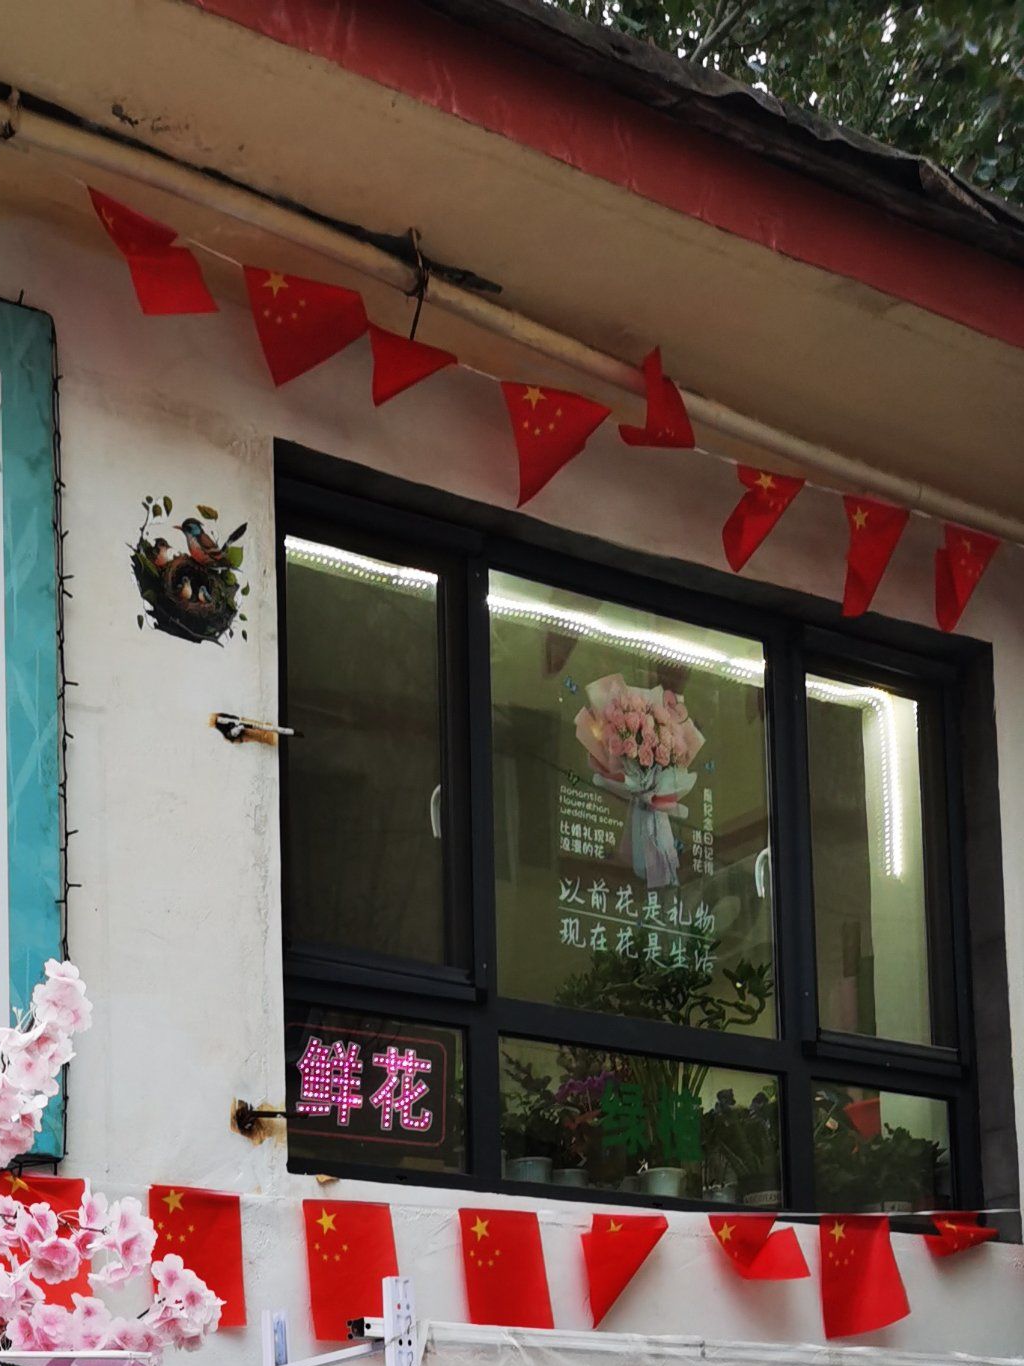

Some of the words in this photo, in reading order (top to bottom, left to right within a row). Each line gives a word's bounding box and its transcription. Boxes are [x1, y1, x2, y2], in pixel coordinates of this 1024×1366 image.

[559, 876, 716, 934] 以前花是礼物
[559, 916, 719, 973] 现在花是生活
[296, 1036, 434, 1133] 鲜花
